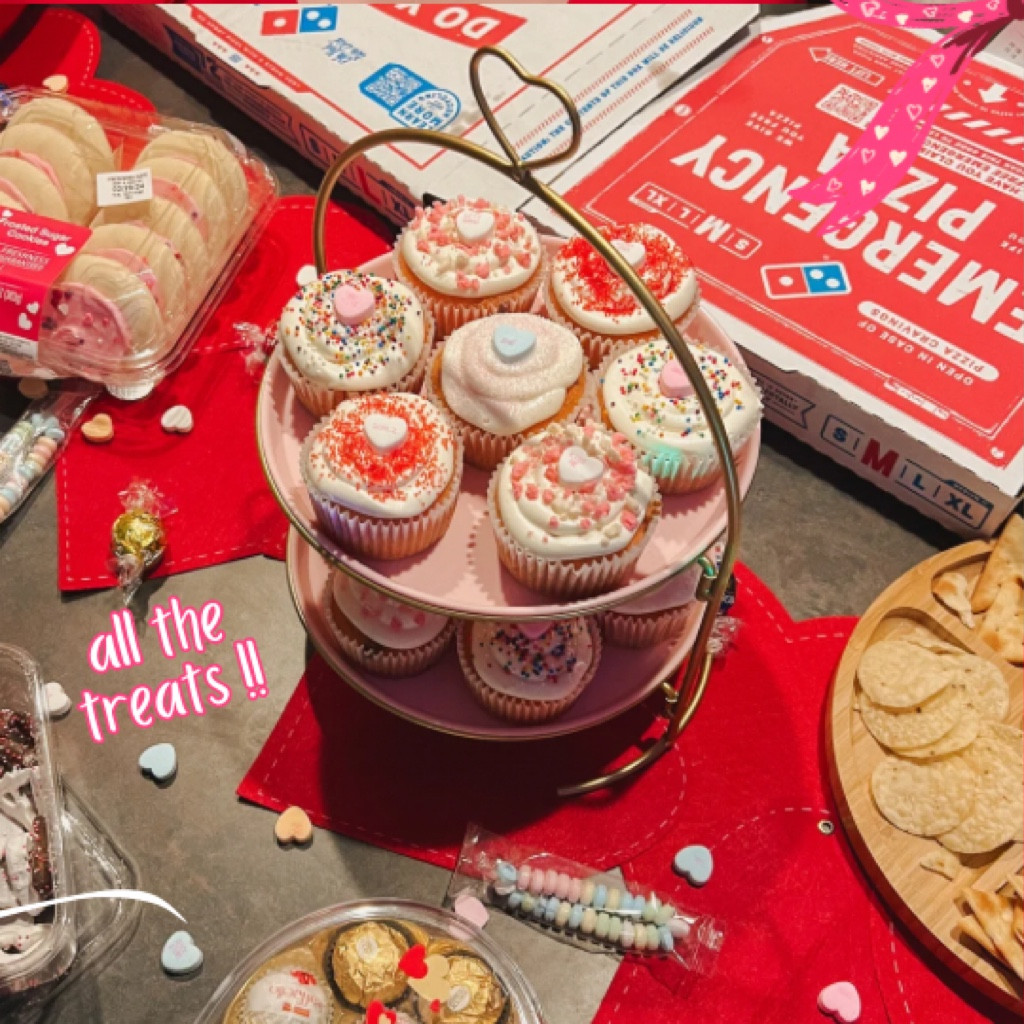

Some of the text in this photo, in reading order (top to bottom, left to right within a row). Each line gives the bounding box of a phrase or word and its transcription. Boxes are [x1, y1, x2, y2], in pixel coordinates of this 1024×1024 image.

[433, 6, 497, 39] DO
[647, 189, 669, 207] XL
[694, 215, 731, 243] M
[857, 320, 974, 386] OPEN IN CASE OF
[870, 308, 985, 373] PIZZA CRAVINGS
[832, 427, 848, 443] S
[861, 438, 899, 478] M
[912, 474, 925, 491] L
[944, 493, 974, 519] XL
